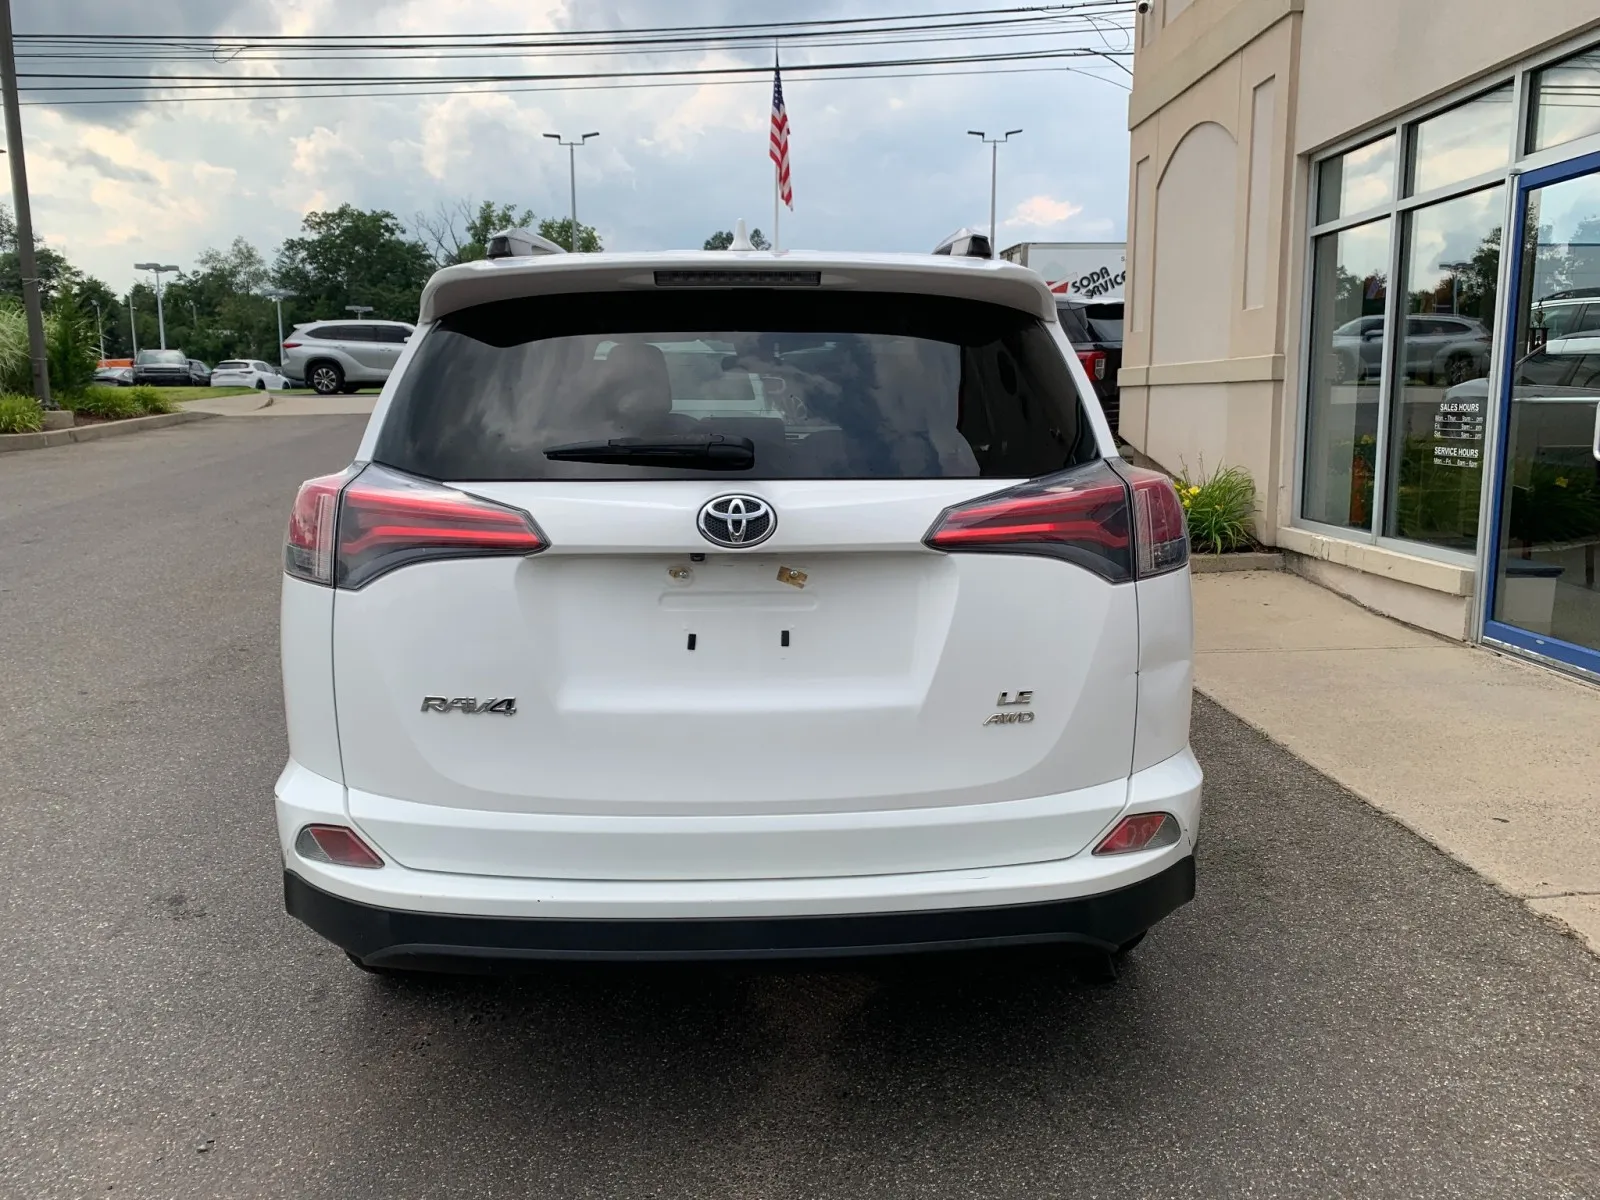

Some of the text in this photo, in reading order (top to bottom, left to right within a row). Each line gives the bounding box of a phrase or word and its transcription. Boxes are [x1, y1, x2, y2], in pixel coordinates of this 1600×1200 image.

[1071, 266, 1110, 293] SODA
[1440, 403, 1480, 411] SALES HOURS
[1434, 446, 1479, 458] SERVICE HOURS
[421, 695, 517, 716] RAV4
[997, 690, 1033, 706] LE
[983, 711, 1035, 726] AWD
